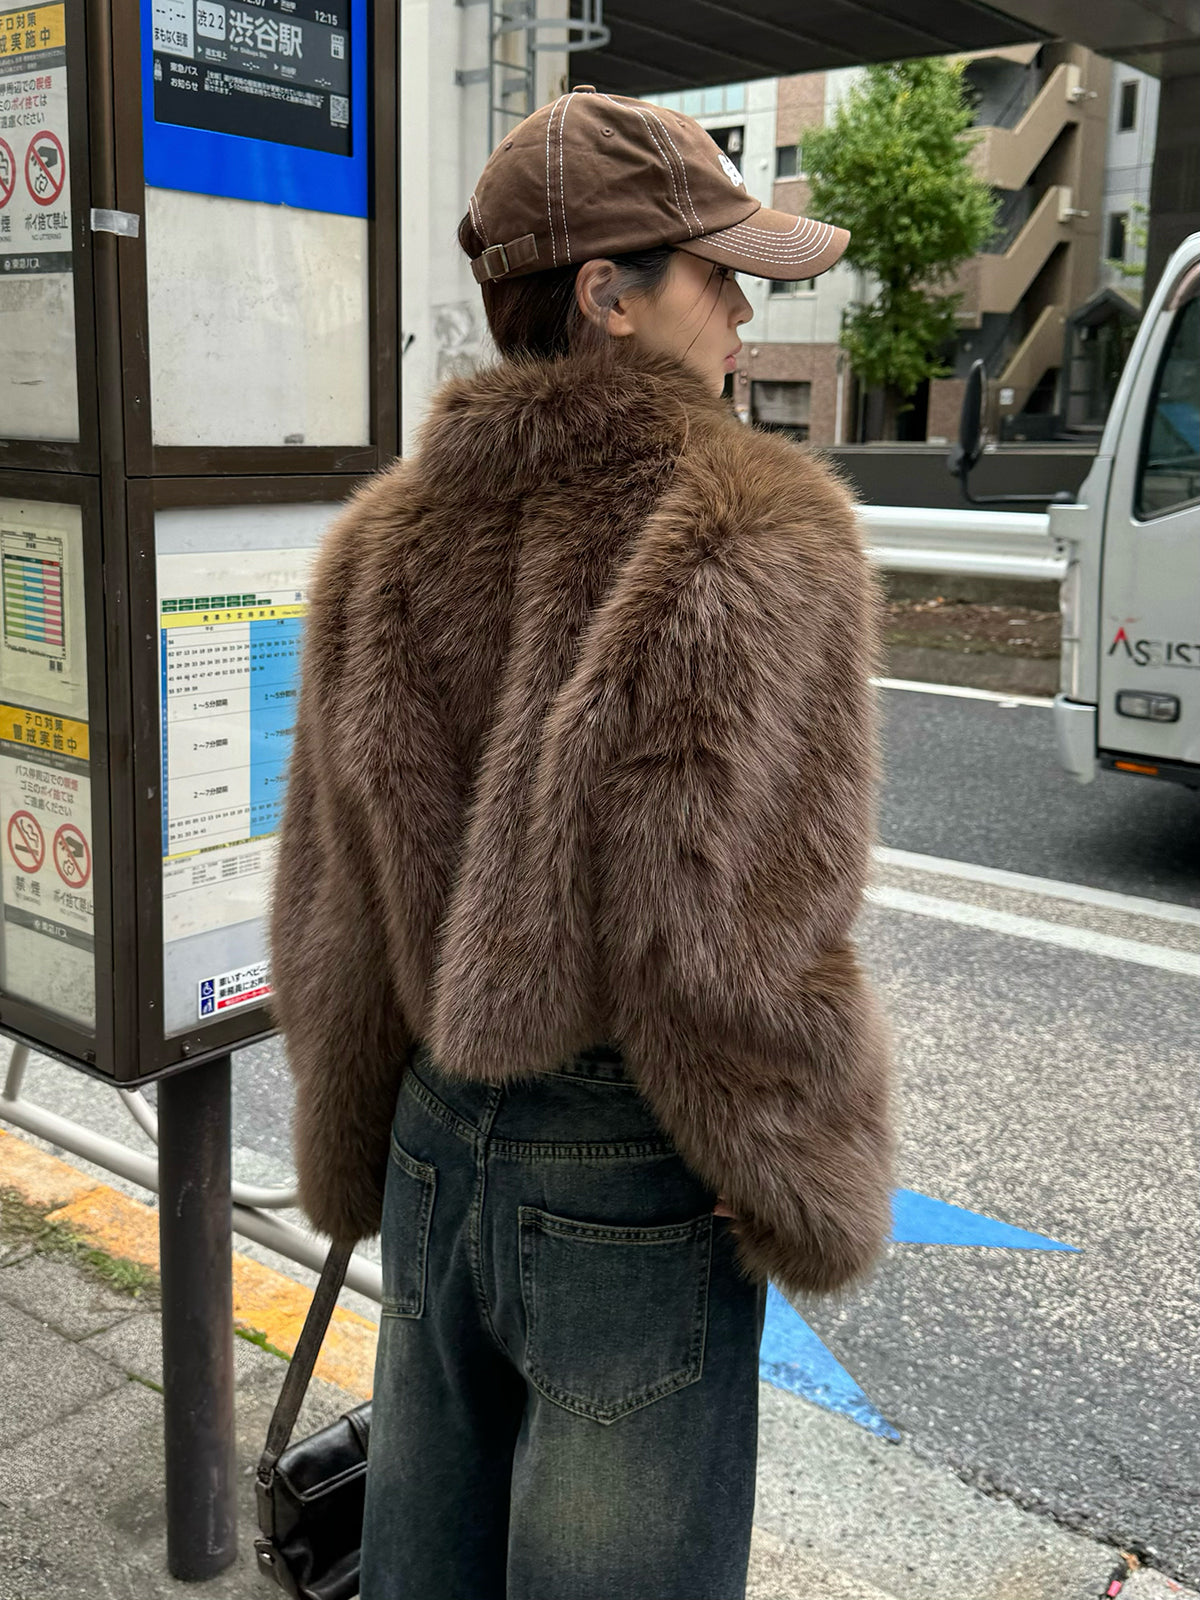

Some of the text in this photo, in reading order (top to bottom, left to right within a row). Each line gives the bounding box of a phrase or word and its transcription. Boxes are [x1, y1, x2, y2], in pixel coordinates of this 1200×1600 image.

[315, 10, 338, 26] 12:15
[229, 9, 303, 59] 渋谷駅
[170, 62, 198, 76] 東急バス
[170, 78, 198, 92] お知らせ
[25, 211, 69, 231] ポイ捨て禁止
[25, 712, 64, 732] テロ対策
[13, 723, 77, 753] 警戒実施中
